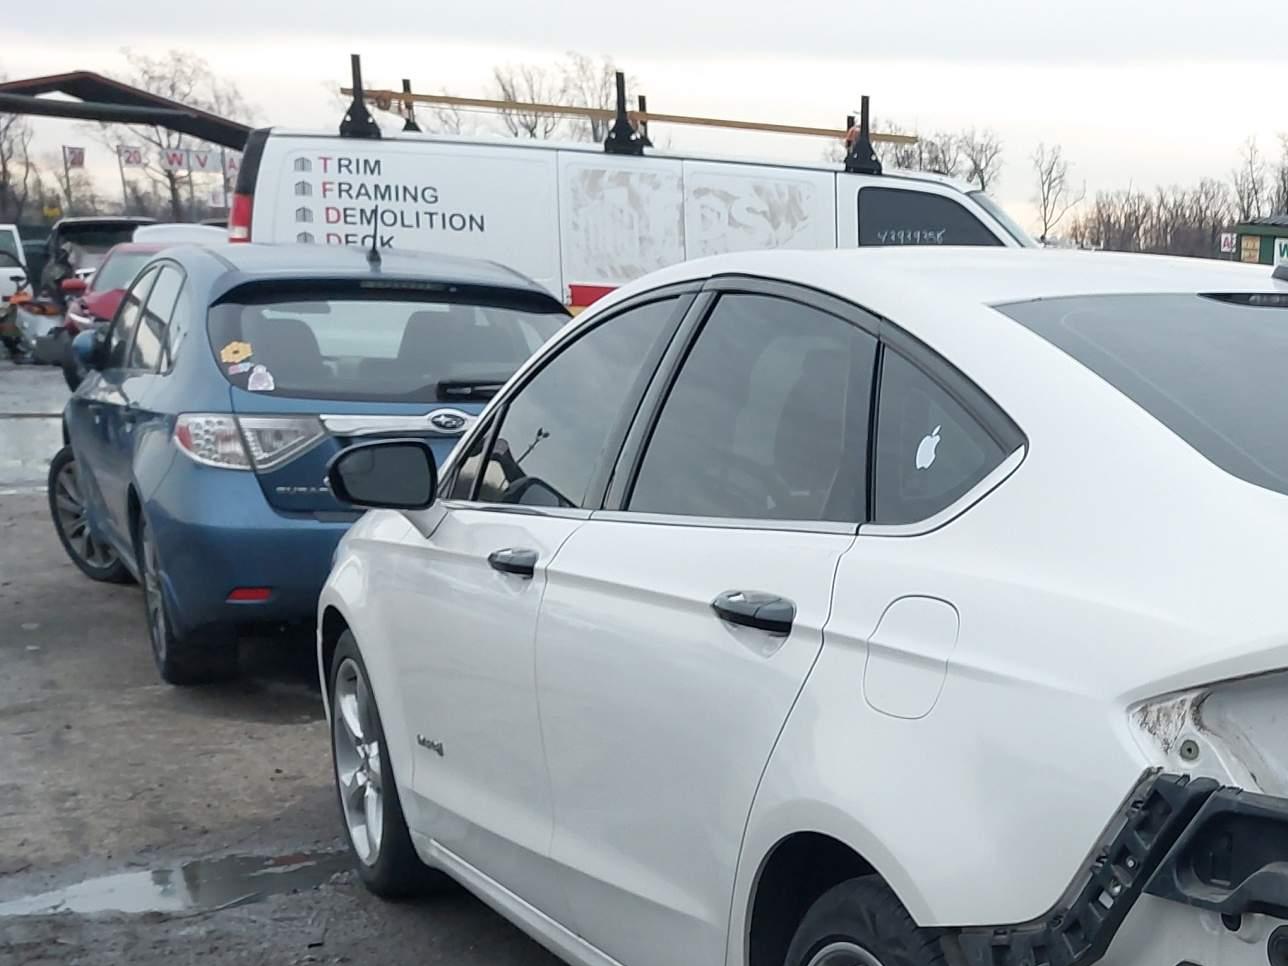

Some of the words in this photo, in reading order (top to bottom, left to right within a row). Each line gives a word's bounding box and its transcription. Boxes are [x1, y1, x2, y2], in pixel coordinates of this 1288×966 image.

[165, 152, 184, 167] W
[195, 154, 208, 169] V
[318, 156, 381, 176] TRIM
[321, 181, 439, 204] FRAMING
[325, 206, 485, 232] DEMOLITION
